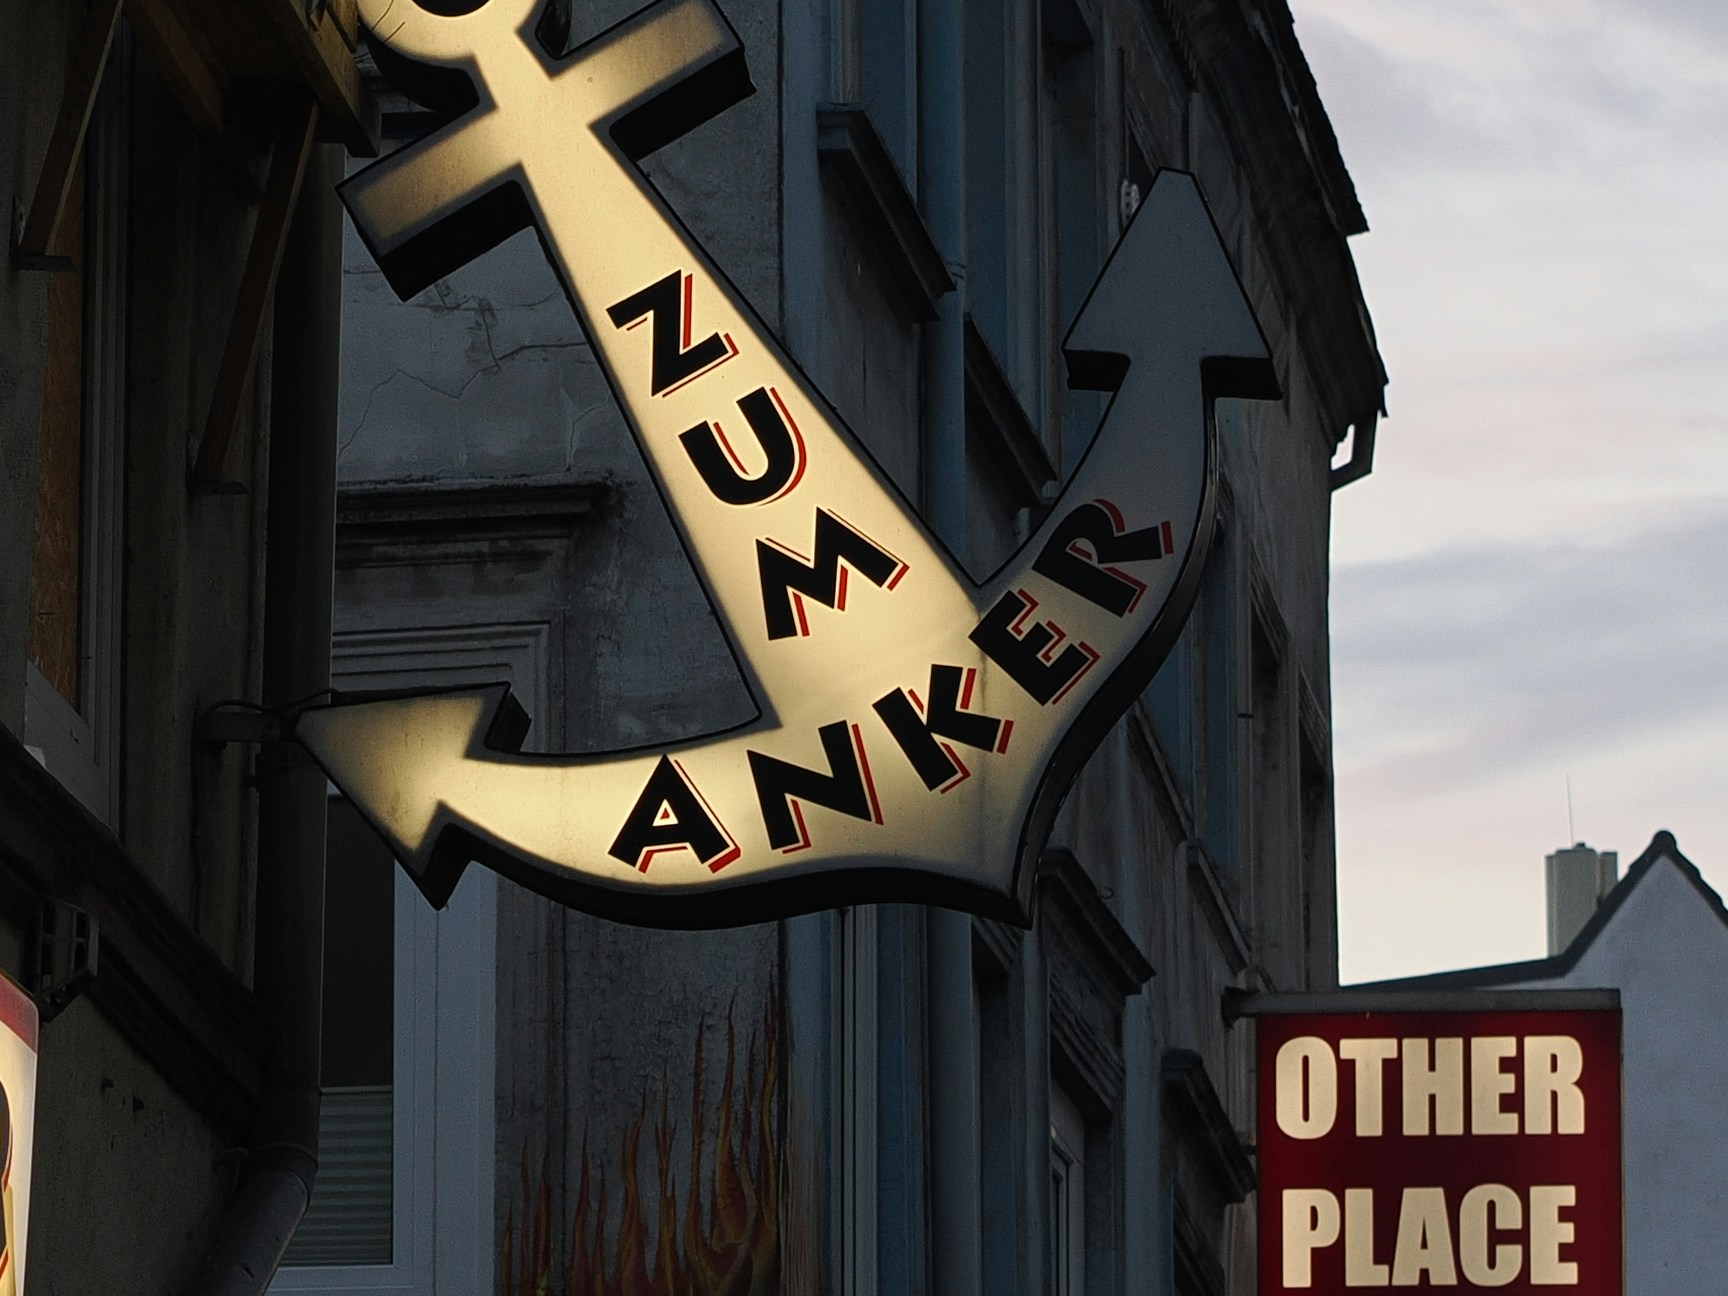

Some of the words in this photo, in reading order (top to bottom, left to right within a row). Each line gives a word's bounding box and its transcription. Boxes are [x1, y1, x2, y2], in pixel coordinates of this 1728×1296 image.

[607, 269, 907, 639] ZUM
[608, 498, 1173, 873] ANKER
[1275, 1035, 1586, 1141] OTHER
[1281, 1182, 1580, 1289] PLACE
